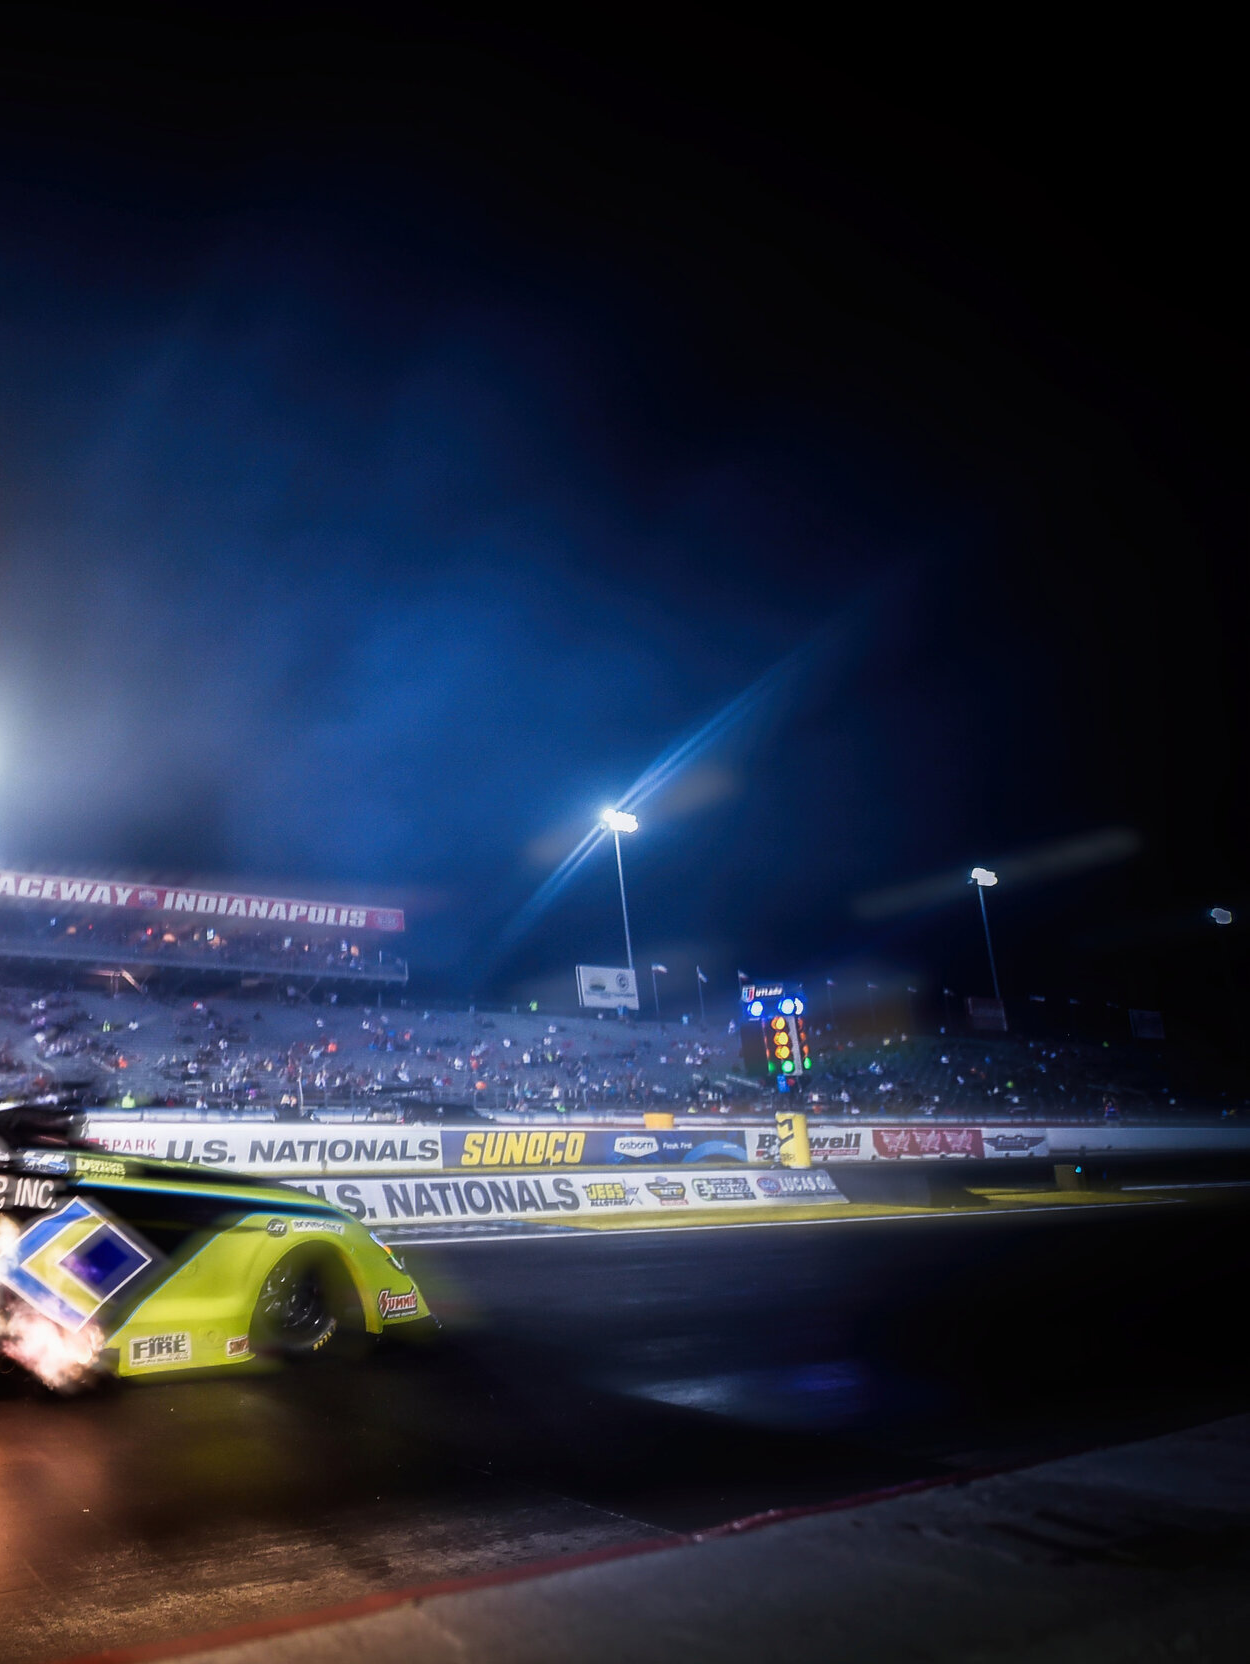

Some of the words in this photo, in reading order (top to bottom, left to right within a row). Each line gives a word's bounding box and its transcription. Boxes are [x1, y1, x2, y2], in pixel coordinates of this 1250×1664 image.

[162, 890, 368, 929] INDIANAPOLIS
[102, 1138, 157, 1152] SPARK
[166, 1139, 237, 1164] U.S.
[250, 1139, 440, 1164] NATIONALS
[460, 1132, 587, 1167] SUNOCO
[619, 1141, 654, 1150] osborn
[13, 1177, 58, 1209] INC.
[586, 1183, 626, 1200] JEGS
[778, 1176, 817, 1192] LUCAS
[382, 1177, 582, 1219] NATIONALS
[132, 1340, 187, 1361] FIRE
